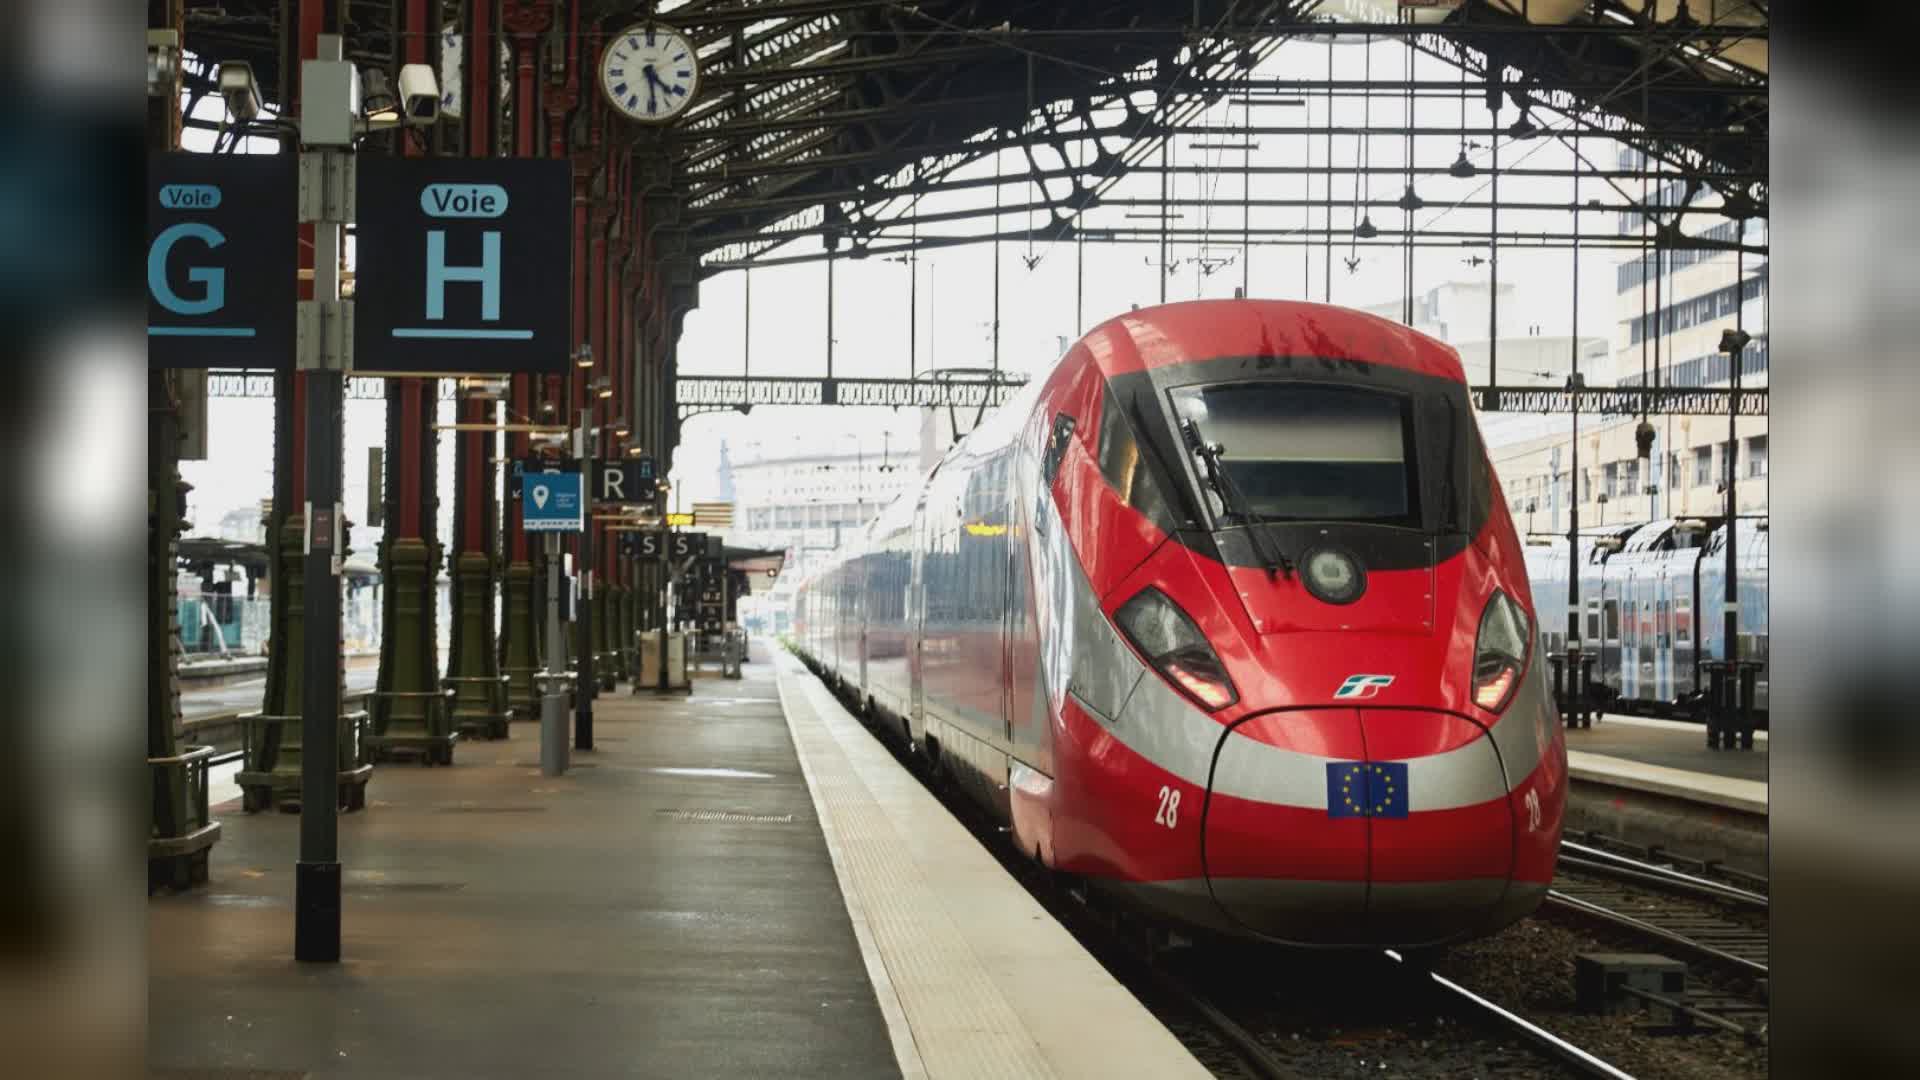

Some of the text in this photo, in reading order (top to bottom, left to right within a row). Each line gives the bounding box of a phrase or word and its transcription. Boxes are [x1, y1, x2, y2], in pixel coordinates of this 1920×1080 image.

[168, 188, 212, 206] Voie
[431, 188, 496, 213] Voie
[147, 222, 226, 315] G
[426, 230, 501, 321] H
[603, 468, 625, 499] R
[643, 536, 656, 554] S
[676, 536, 689, 555] S
[1154, 785, 1181, 829] 28
[1524, 787, 1541, 832] 28
